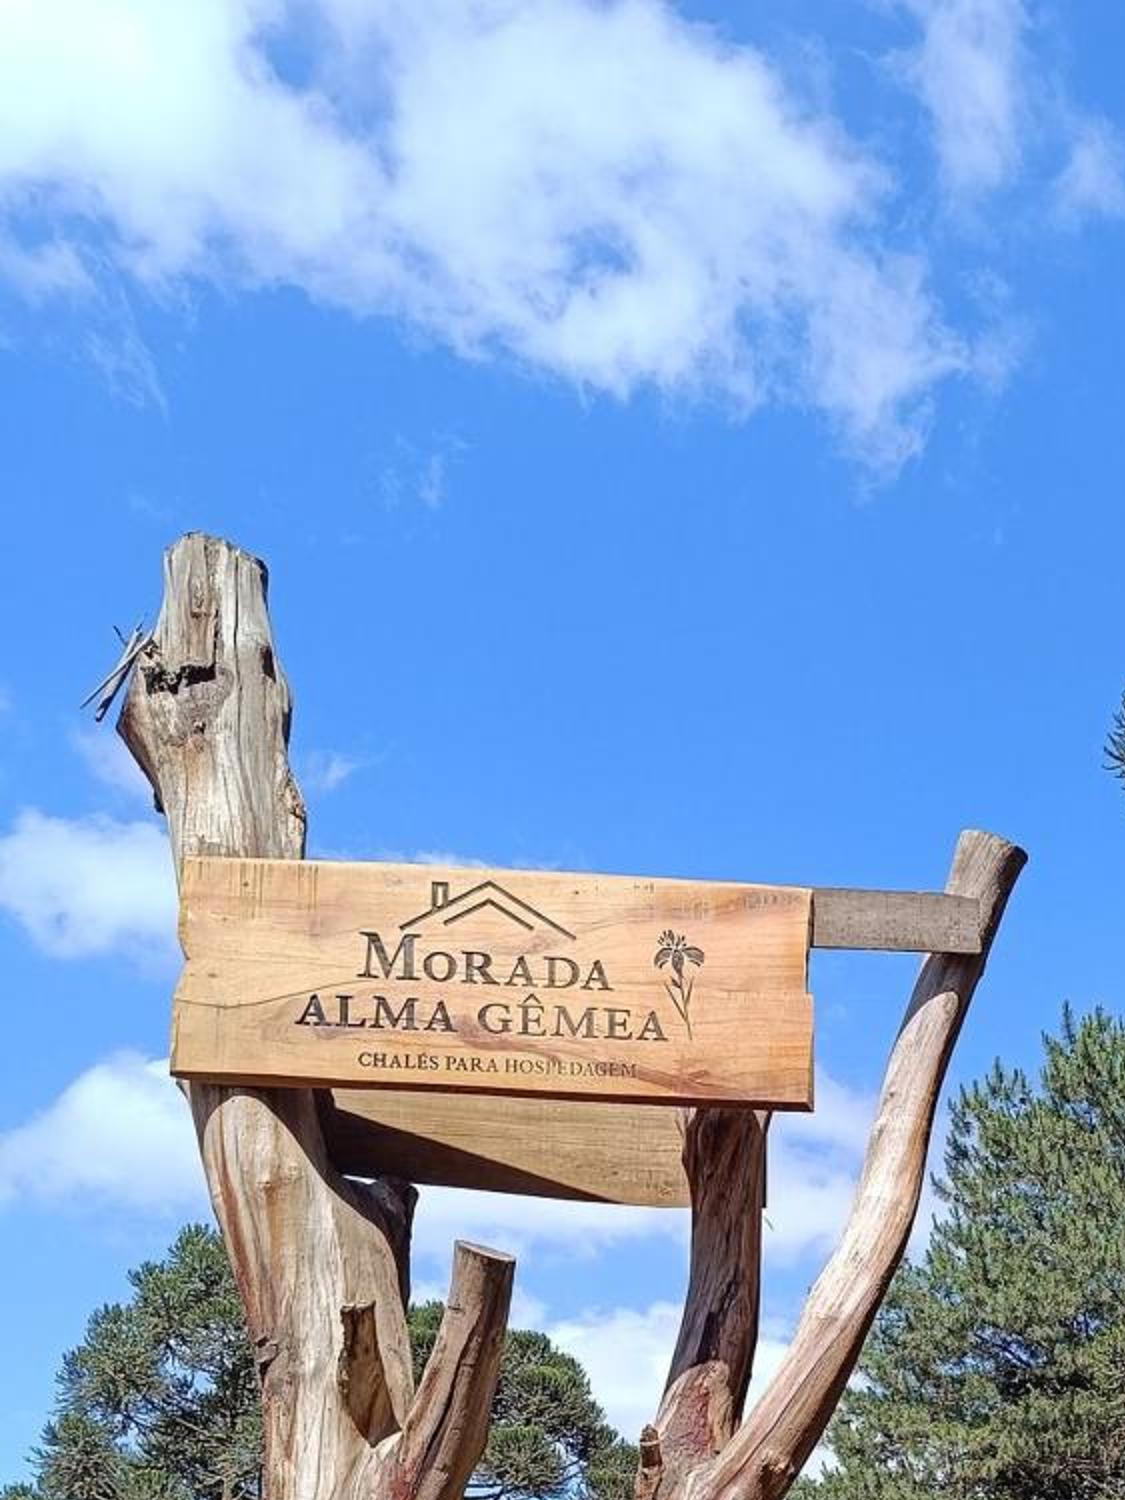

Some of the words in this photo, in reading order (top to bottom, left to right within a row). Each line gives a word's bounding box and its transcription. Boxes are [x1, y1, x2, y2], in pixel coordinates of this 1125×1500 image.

[357, 931, 613, 991] MORADA
[295, 994, 458, 1032] ALMA
[477, 993, 668, 1041] GÊMEA
[358, 1051, 439, 1070] CHALÉS
[446, 1055, 499, 1073] PARA
[505, 1058, 637, 1078] HOSPEDAGEM
